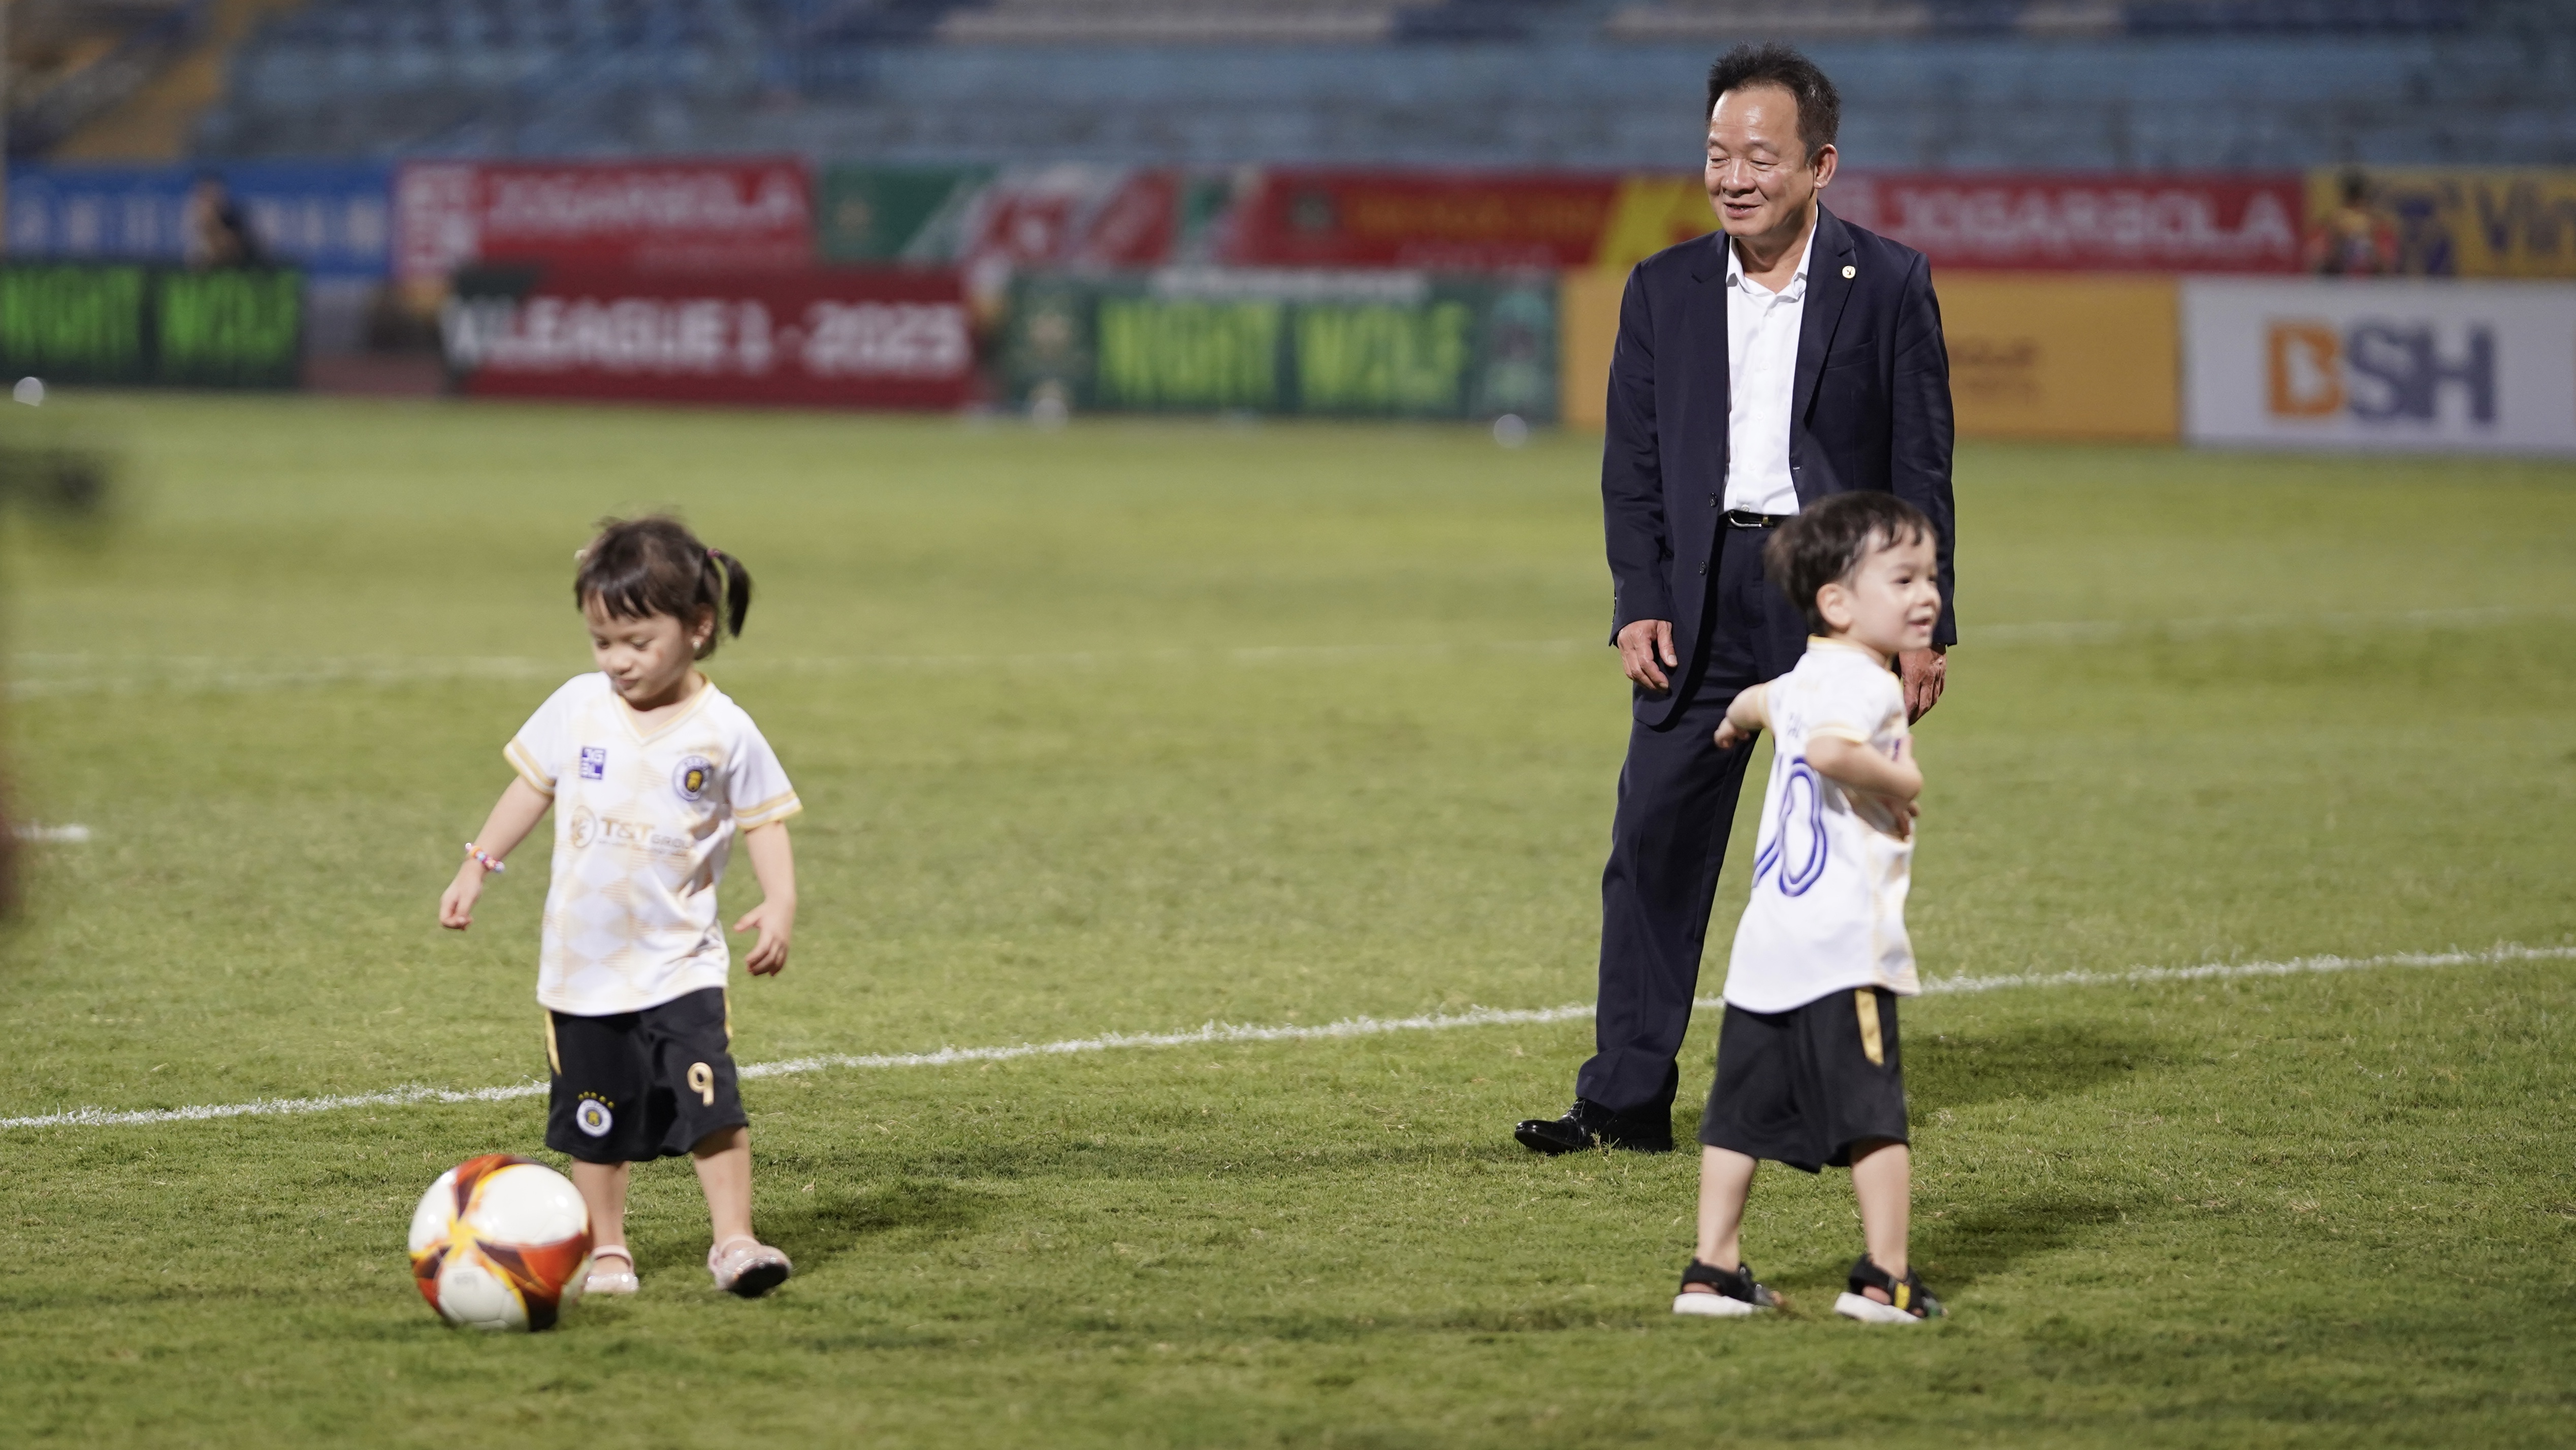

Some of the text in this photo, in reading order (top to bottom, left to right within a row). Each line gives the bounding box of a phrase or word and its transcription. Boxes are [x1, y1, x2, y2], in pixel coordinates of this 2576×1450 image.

[487, 172, 801, 231] JOGARBOLA
[1894, 184, 2295, 250] JOGARBOLA
[803, 300, 968, 376] 2025
[2265, 318, 2499, 424] BSH
[601, 816, 655, 842] T&T
[687, 1062, 714, 1106] 9
